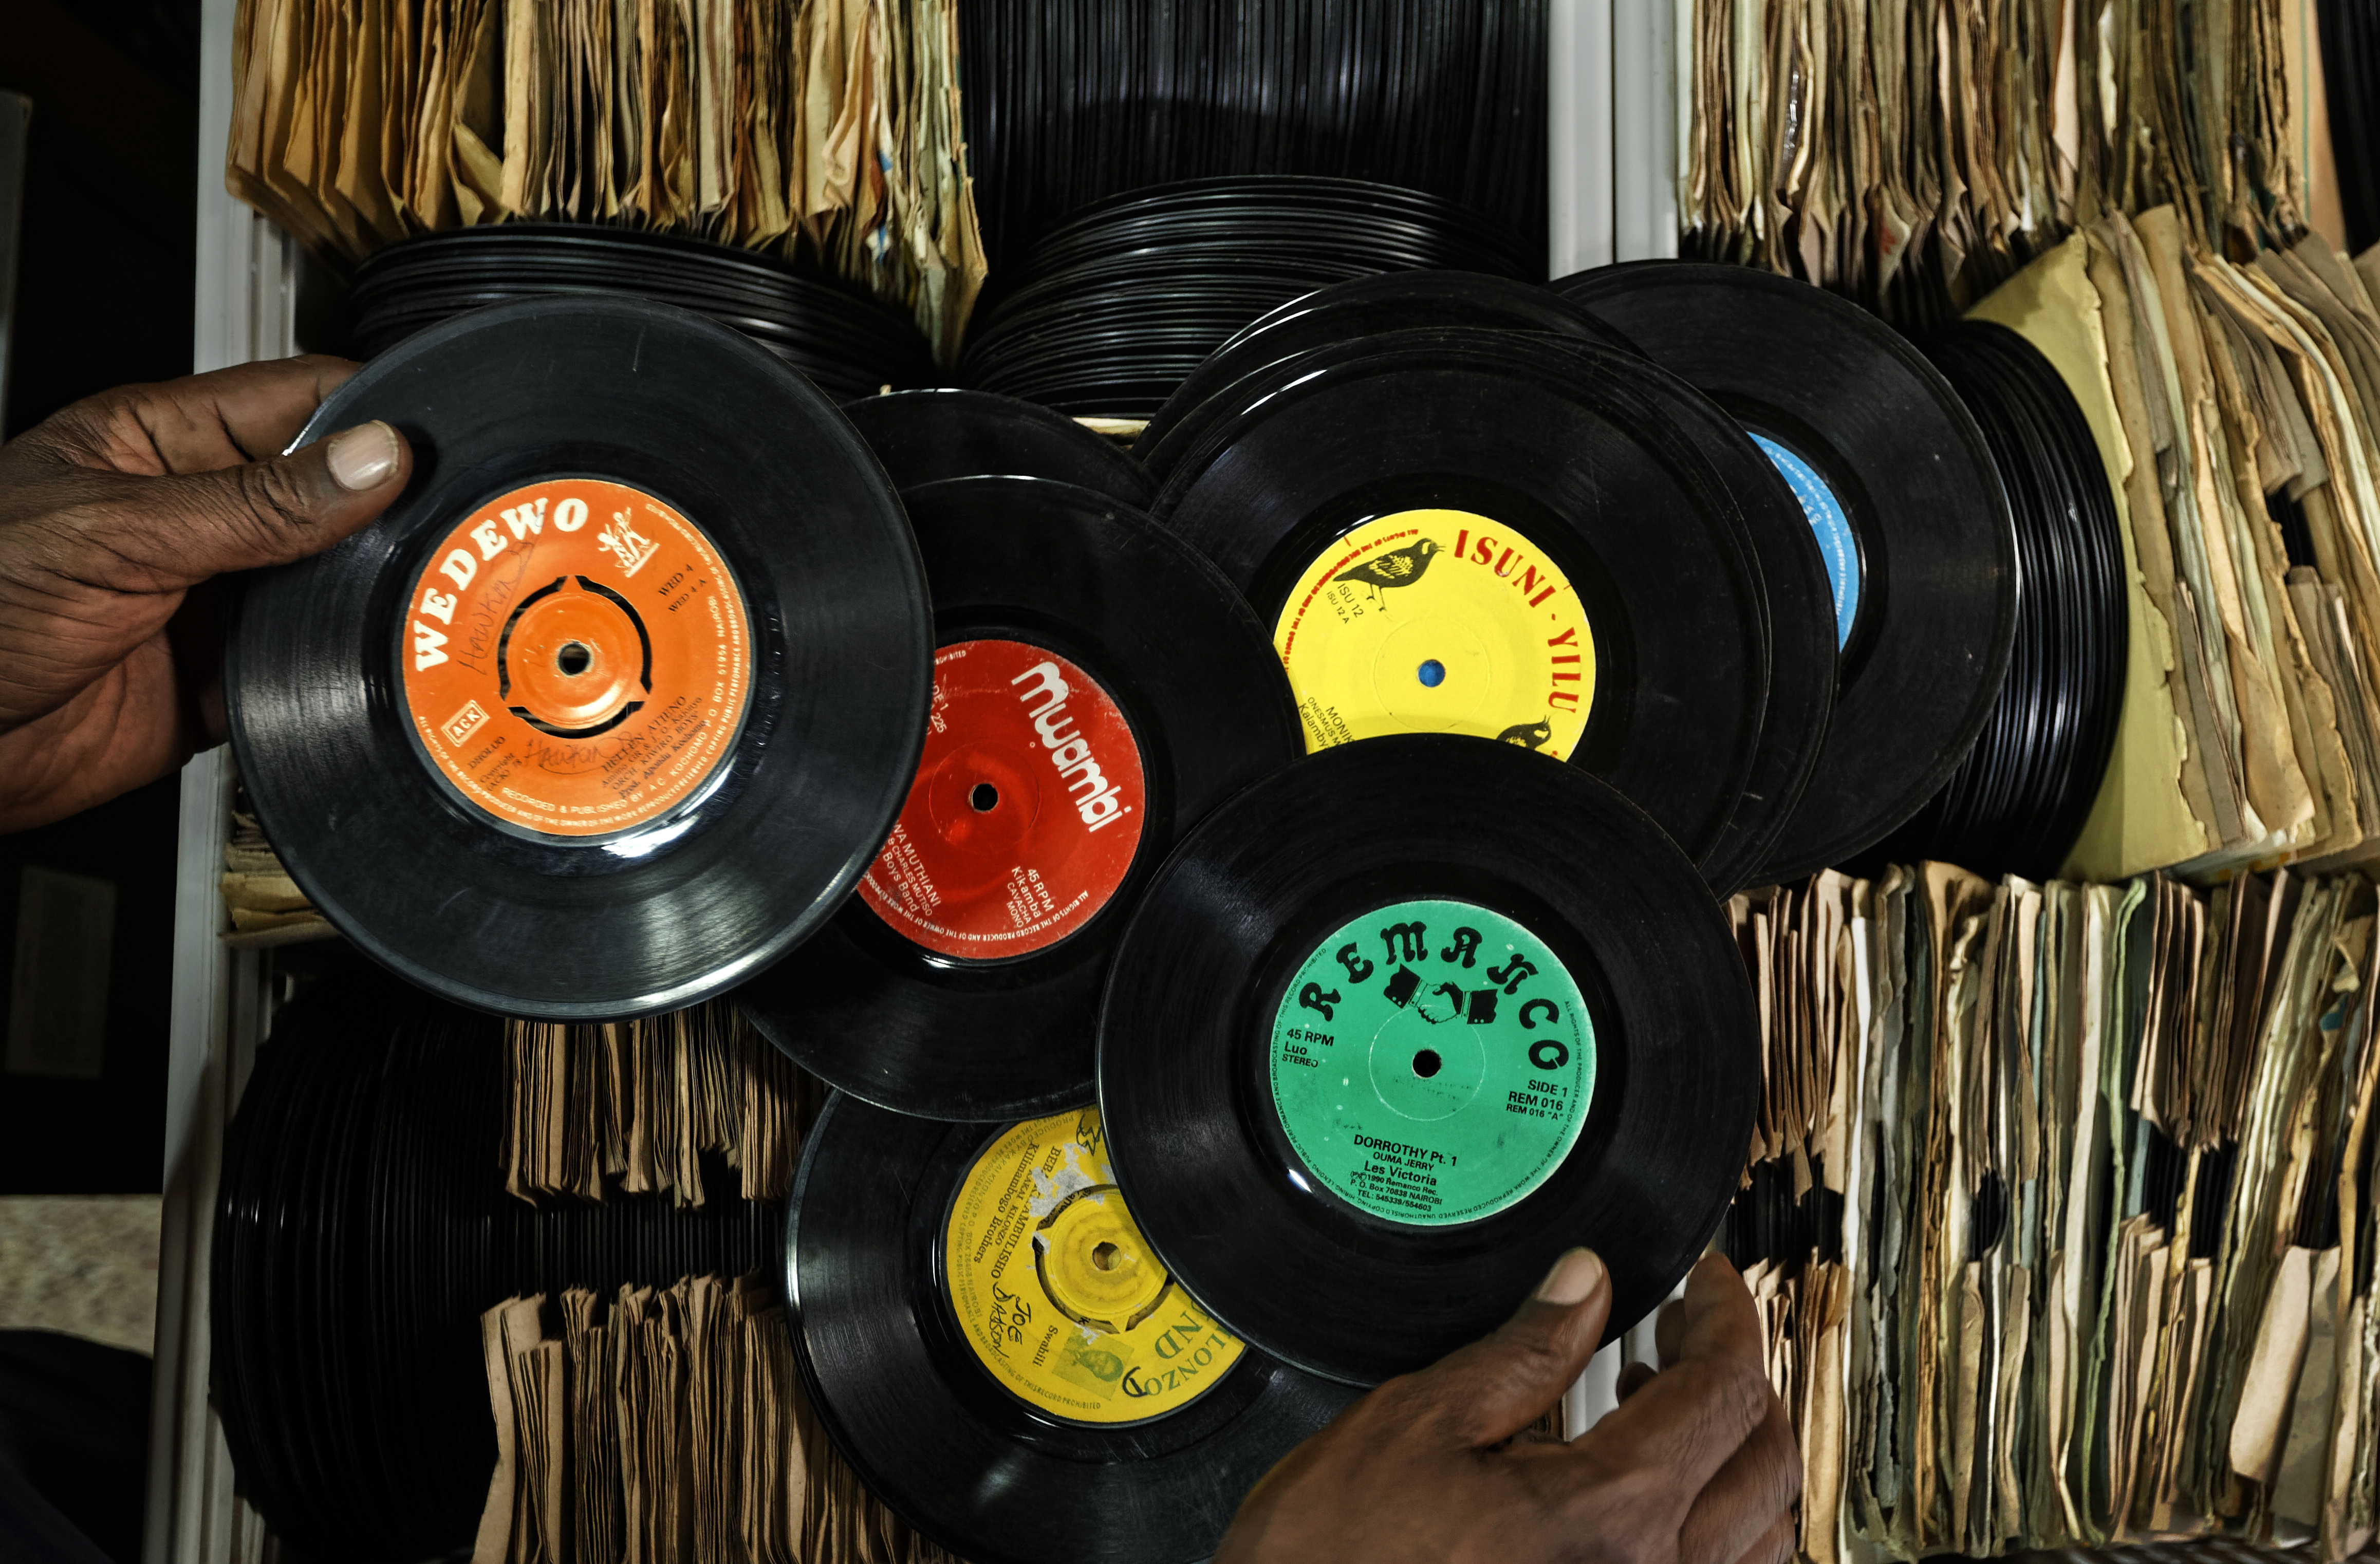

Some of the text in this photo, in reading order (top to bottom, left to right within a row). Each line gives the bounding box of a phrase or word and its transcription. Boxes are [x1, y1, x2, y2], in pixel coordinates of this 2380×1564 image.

[414, 497, 588, 671] WEDEWO
[658, 564, 693, 596] WED 4
[668, 593, 689, 612] WED
[1326, 591, 1339, 605] ISU
[1336, 606, 1345, 616] 12
[1337, 583, 1364, 618] ISU 12
[1454, 529, 1556, 608] ISUNI
[1548, 626, 1581, 714] YILU
[452, 710, 481, 746] ACK
[930, 712, 947, 733] 225
[1298, 703, 1328, 749] Kalamby
[1308, 697, 1336, 737] ONESMUS
[1011, 661, 1131, 832] mwambi
[501, 787, 555, 812] RECORDED
[570, 796, 627, 814] PUBLISHED
[629, 791, 643, 802] BY
[882, 851, 920, 912] Boys Band
[891, 845, 916, 884] CHARLES
[912, 882, 933, 916] MUTISO
[902, 843, 941, 907] MUTHIANI
[1011, 866, 1048, 918] Kikamba
[1027, 869, 1054, 911] 45 RPM
[1077, 890, 1089, 902] ALL
[903, 909, 914, 921] THE
[1007, 883, 1036, 924] CAVACHA
[1007, 901, 1024, 928] MONO
[1059, 899, 1080, 917] RIGHTS
[945, 929, 957, 939] THE
[1016, 923, 1040, 937] RECORD
[1040, 918, 1052, 928] THE
[982, 932, 1015, 941] PRODUCER
[1284, 1041, 1308, 1055] Luo
[1287, 1028, 1334, 1047] 45 RPM
[1281, 1053, 1318, 1068] STEREO
[1508, 1091, 1564, 1111] REM 016
[1527, 1079, 1568, 1097] SIDE 1
[1506, 1103, 1528, 1114] REM
[1529, 1108, 1545, 1118] 016
[1353, 1134, 1457, 1166] DORROTHY Pt. 1
[1372, 1151, 1435, 1171] OUMA JERRY
[998, 1139, 1040, 1213] Kilimambogo
[1364, 1160, 1385, 1175] Les
[1389, 1165, 1437, 1186] Victoria
[1358, 1188, 1371, 1199] TEL:
[1369, 1183, 1384, 1193] Box
[1408, 1191, 1443, 1205] NAIROBI
[1385, 1177, 1421, 1191] Remanco
[1422, 1186, 1437, 1196] Rec.
[995, 1204, 1019, 1246] KILONZO
[973, 1215, 1003, 1263] Brothers
[1032, 1325, 1058, 1368] Swahili
